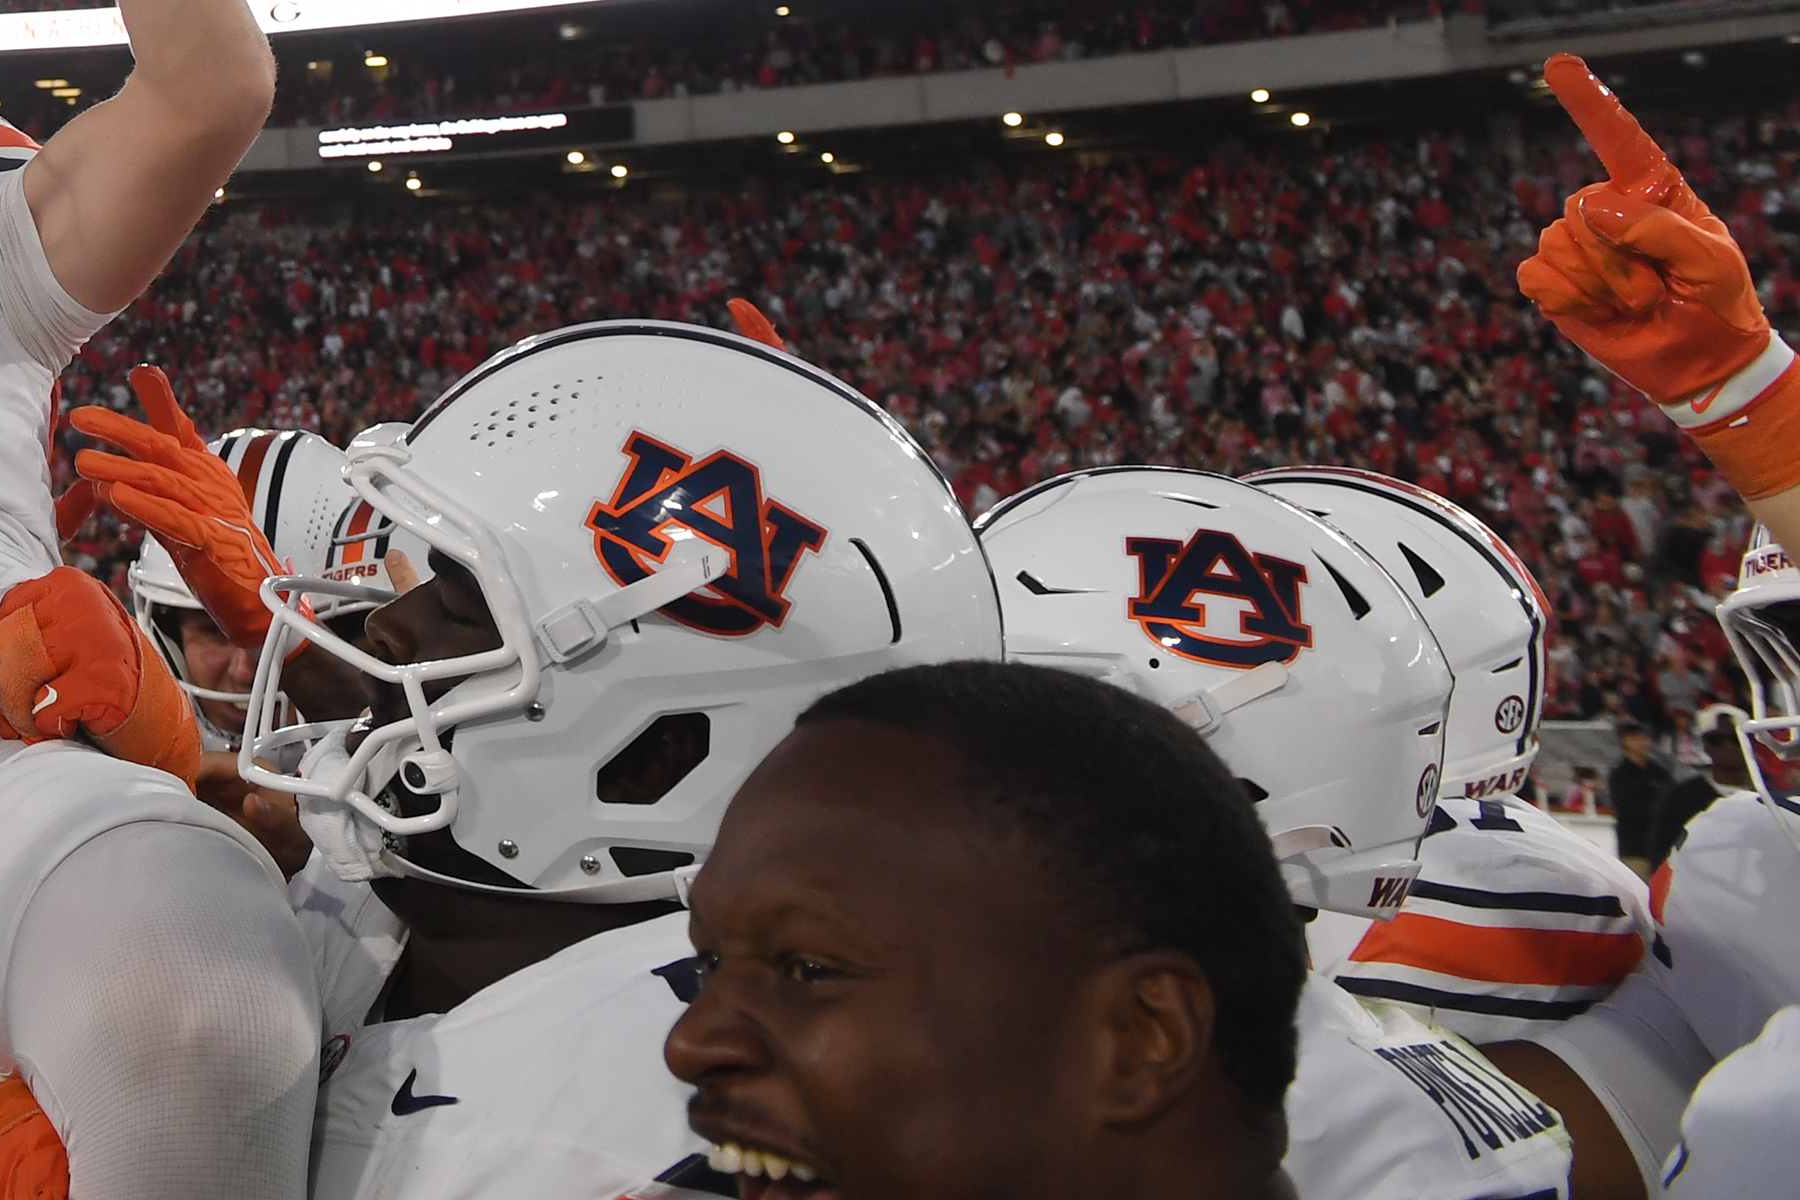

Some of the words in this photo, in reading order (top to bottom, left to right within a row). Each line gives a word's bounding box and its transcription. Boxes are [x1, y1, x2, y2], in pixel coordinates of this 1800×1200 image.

[47, 14, 126, 39] ATHEN
[321, 563, 379, 582] TIGERS
[1745, 553, 1797, 579] TIGER
[1498, 697, 1523, 733] SEC
[1464, 767, 1526, 799] WAR
[1367, 877, 1414, 908] WA
